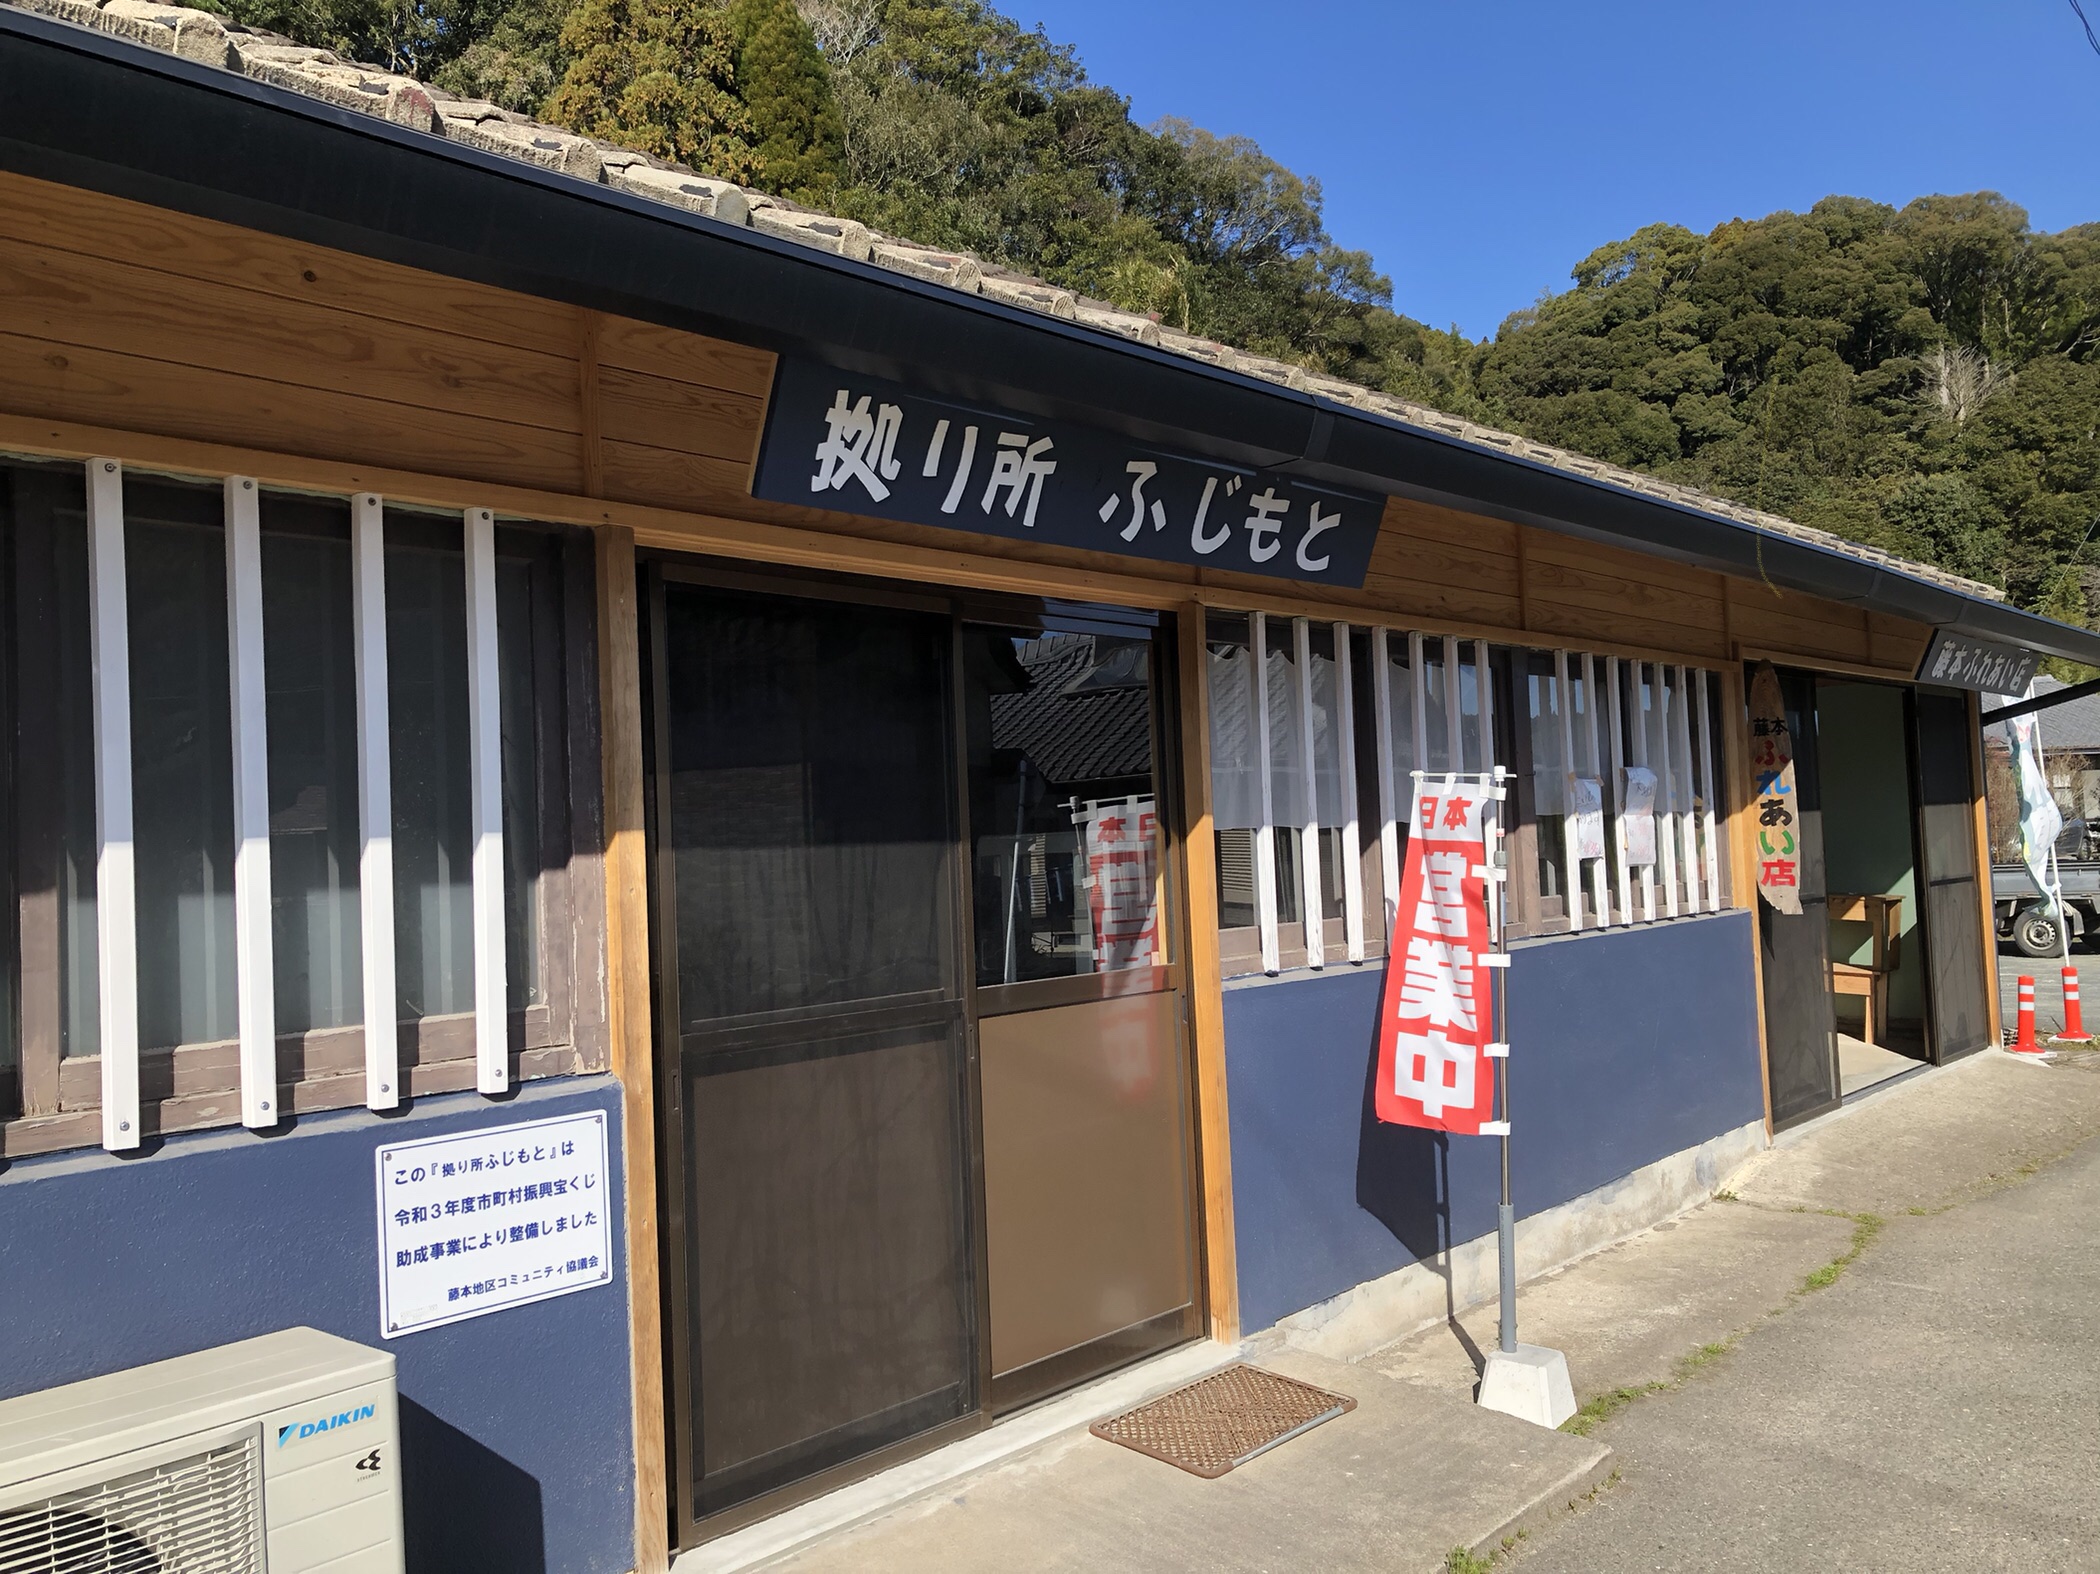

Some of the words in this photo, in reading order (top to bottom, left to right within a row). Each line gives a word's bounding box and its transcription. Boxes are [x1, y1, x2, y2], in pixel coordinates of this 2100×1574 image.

[811, 389, 1057, 527] 拠り所
[1099, 461, 1341, 571] ふじもと
[1931, 640, 2031, 692] 藤本ふれあい店
[1753, 717, 1788, 737] 藤本
[1755, 739, 1796, 887] ふれあい店
[1394, 851, 1478, 1119] 営業中
[394, 1140, 575, 1186] この『拠り所ふじもと』は
[394, 1173, 597, 1227] 令和3年度市町村振興宝くじ
[395, 1211, 598, 1268] 助成事業により整備しました
[447, 1255, 599, 1302] 藤本地区コミュニティ協議会
[298, 1404, 376, 1439] DAIKIN
